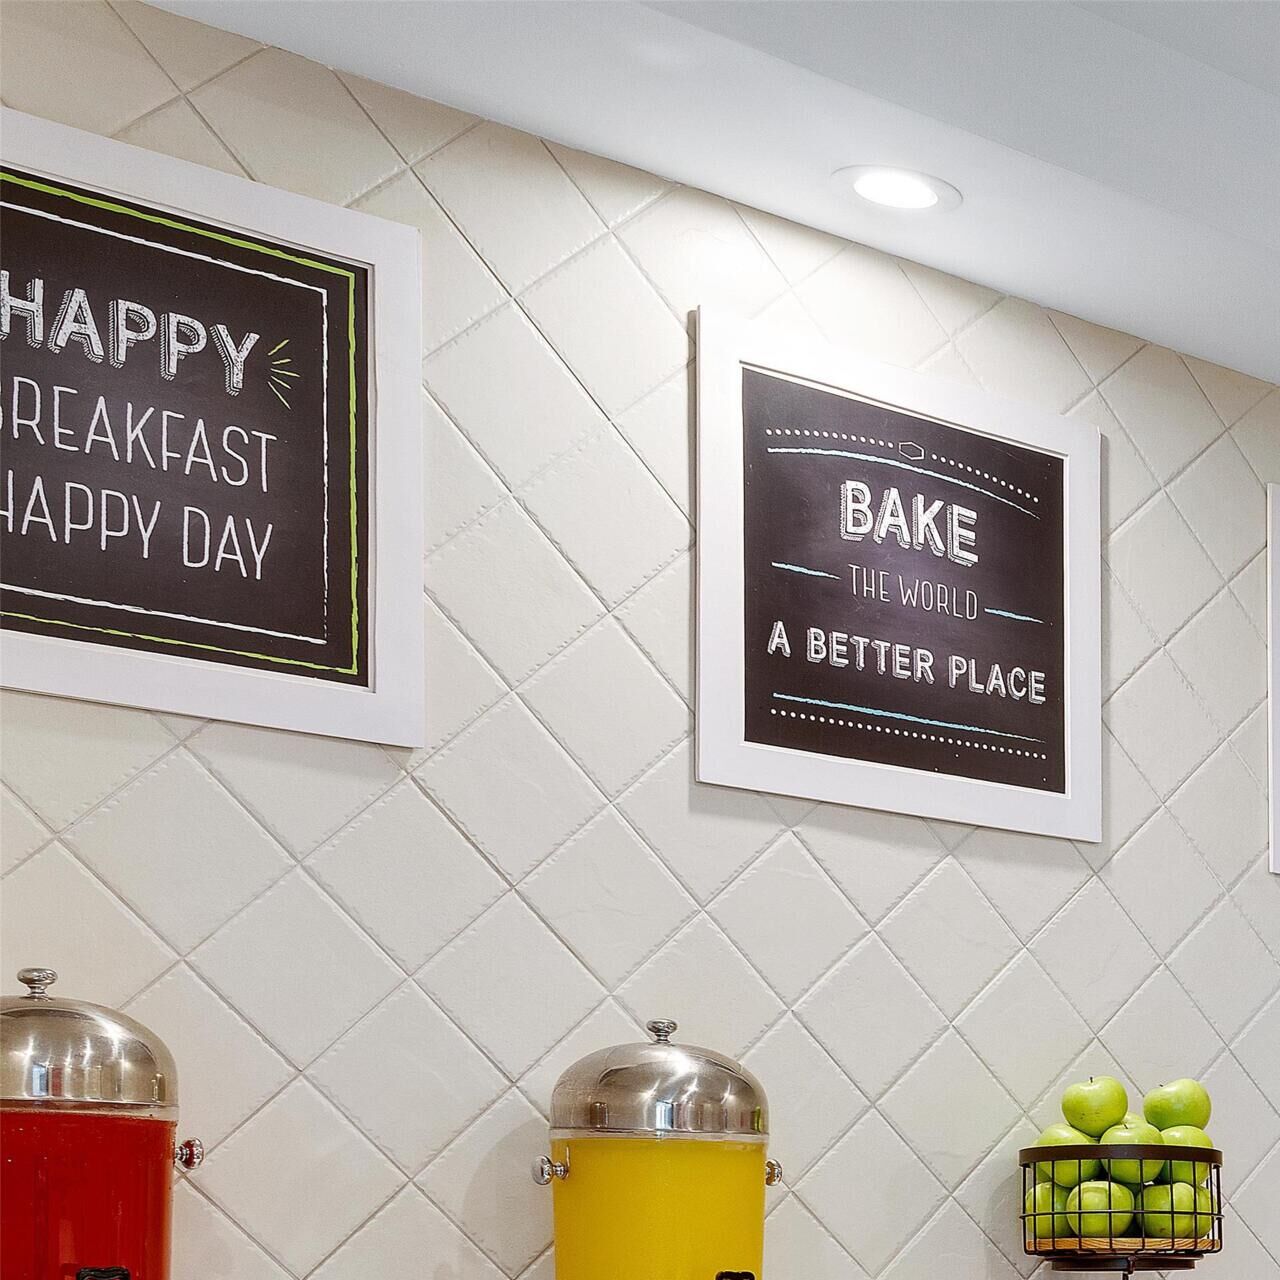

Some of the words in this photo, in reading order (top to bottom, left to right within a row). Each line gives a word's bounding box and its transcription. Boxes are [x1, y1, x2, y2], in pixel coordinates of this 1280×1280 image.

[0, 270, 260, 397] HAPPY
[0, 376, 277, 492] REAKFAST
[183, 507, 273, 580] DAY
[839, 479, 979, 567] BAKE
[848, 563, 891, 602] THE
[897, 574, 978, 621] WORLD
[767, 620, 792, 657] A
[806, 627, 935, 684] BETTER
[947, 653, 1046, 705] PLACE
